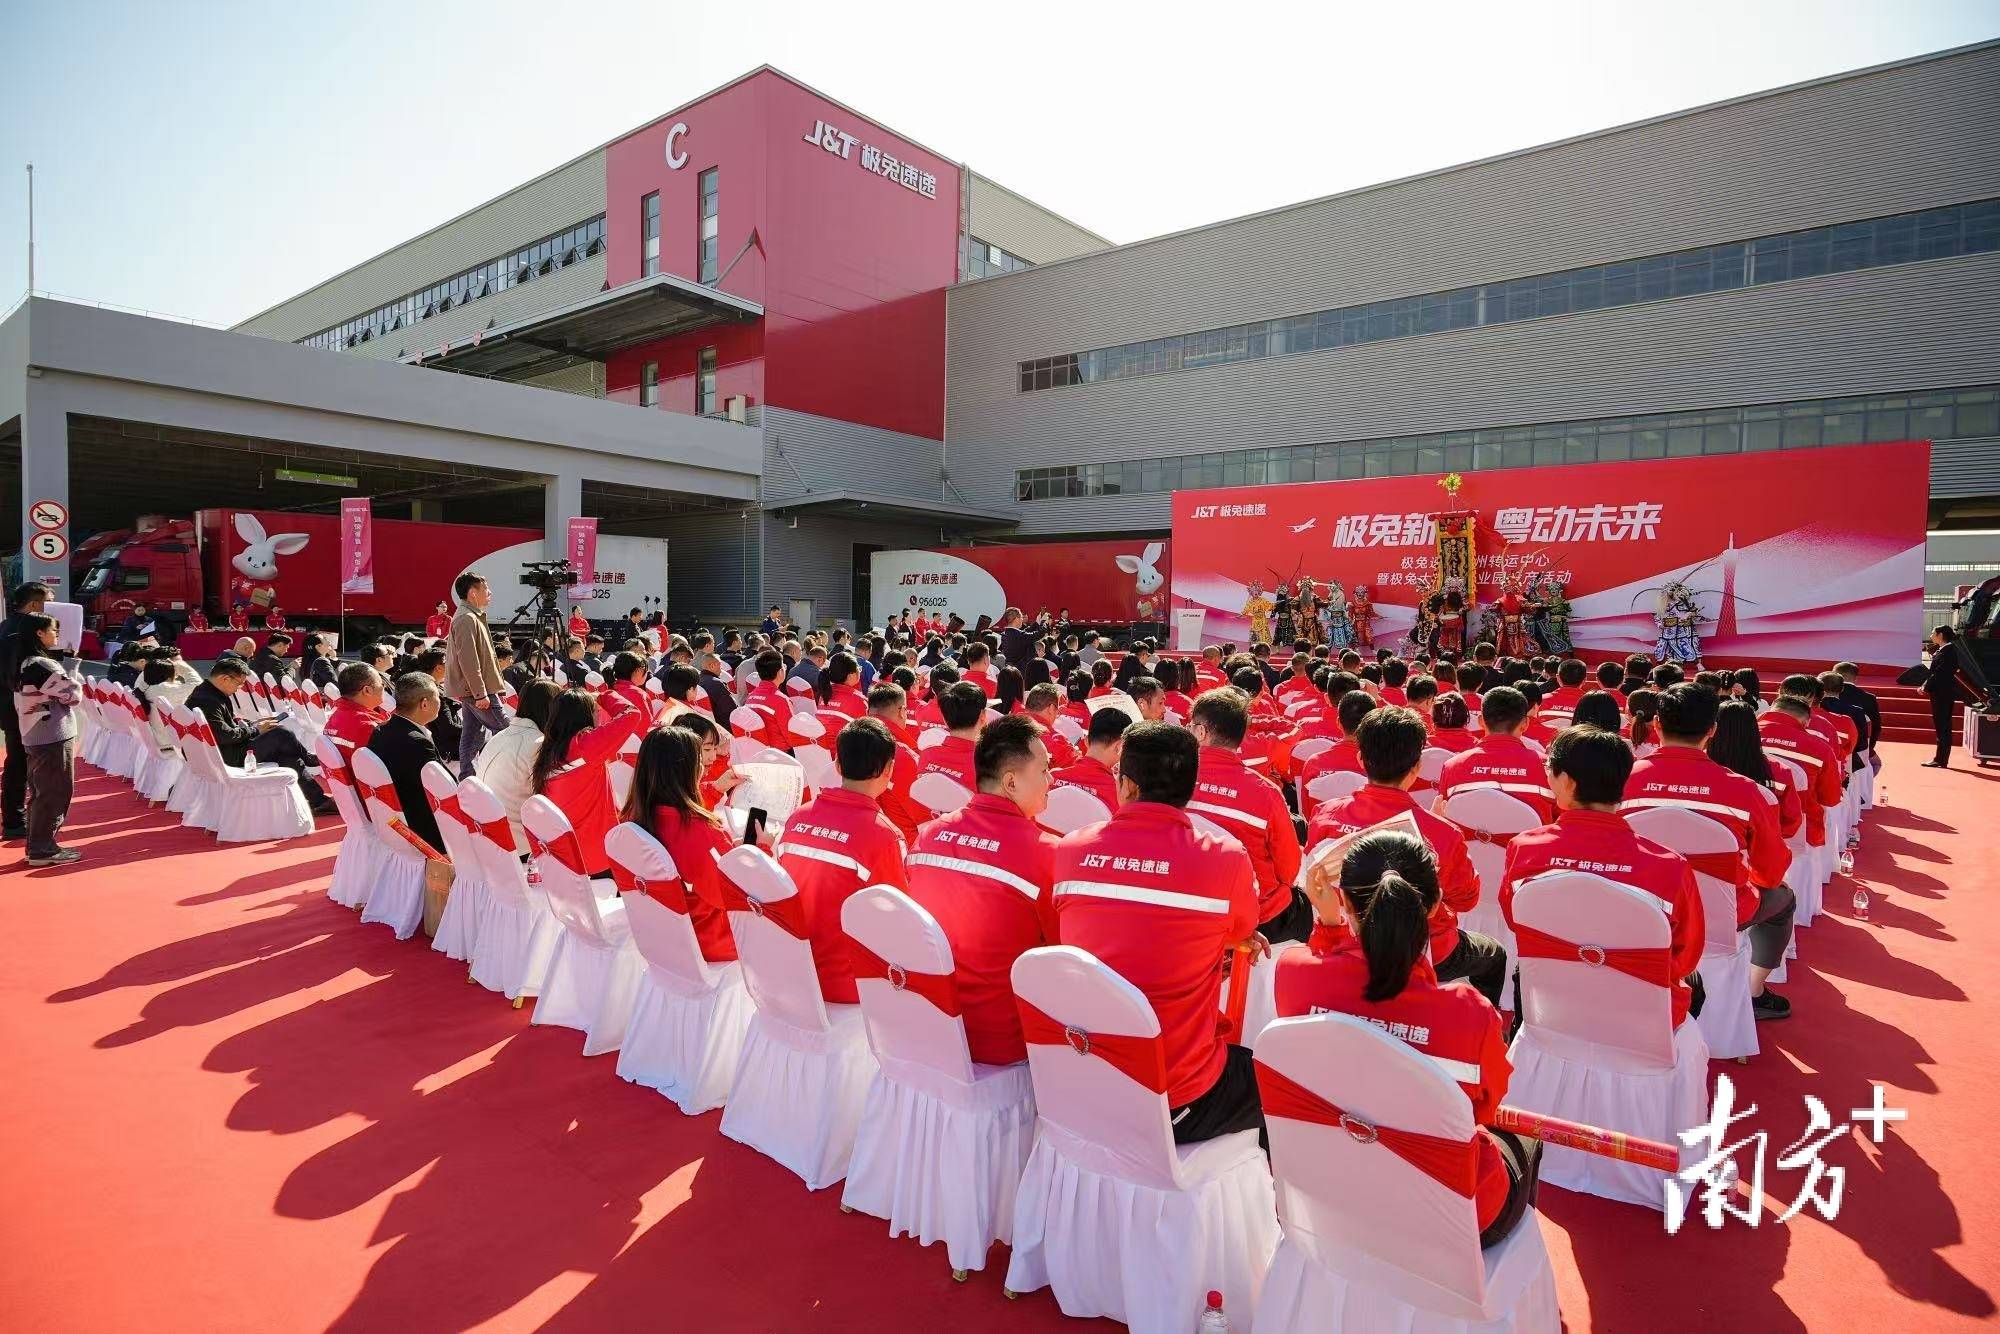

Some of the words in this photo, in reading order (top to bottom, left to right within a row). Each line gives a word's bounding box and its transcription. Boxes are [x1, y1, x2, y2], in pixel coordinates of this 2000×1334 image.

[665, 122, 690, 170] C
[803, 120, 860, 160] J&T
[861, 144, 937, 200] 极兔速递
[1190, 505, 1219, 519] J&T
[1220, 504, 1267, 517] 极兔速递
[1332, 509, 1479, 548] 极兔新
[1494, 502, 1664, 544] 粤动未来
[43, 538, 55, 554] 5
[898, 574, 921, 586] J&T
[921, 573, 959, 585] 极兔速递
[918, 597, 948, 607] 956025
[1470, 766, 1491, 775] J&T
[1491, 766, 1528, 777] 极兔速递
[1199, 782, 1238, 799] 极兔速递
[1643, 782, 1667, 792] J&T
[1667, 784, 1711, 795] 极兔速递
[791, 822, 813, 833] J&T
[811, 826, 849, 844] 极兔速递
[934, 830, 959, 842] J&T
[957, 834, 1000, 853] 极兔速递
[1079, 853, 1112, 868] J&T
[1112, 856, 1170, 875] 极兔速递
[1578, 860, 1633, 873] 极兔速递
